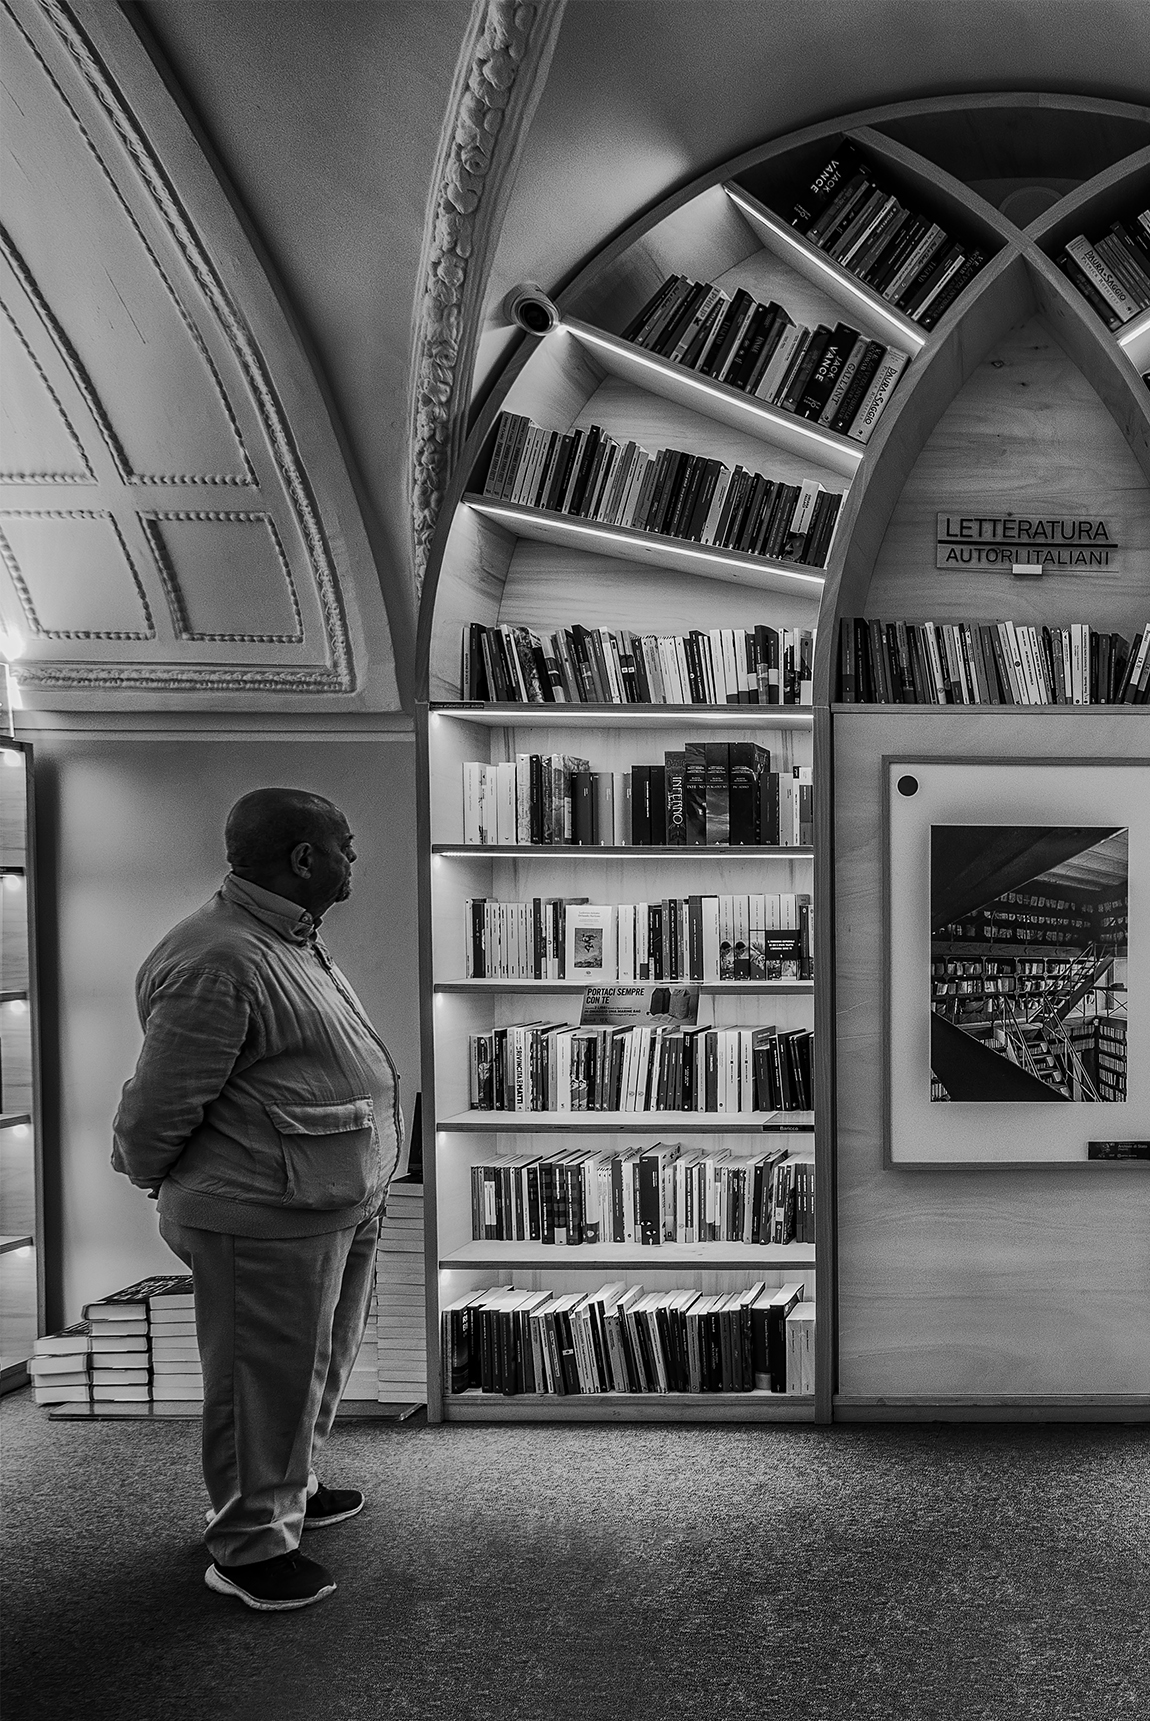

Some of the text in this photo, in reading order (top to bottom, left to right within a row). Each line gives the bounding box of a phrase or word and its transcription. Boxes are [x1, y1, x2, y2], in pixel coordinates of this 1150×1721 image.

[809, 157, 839, 193] VANCE
[821, 170, 842, 193] JACK
[814, 343, 838, 382] VANCE
[826, 354, 843, 380] JACK
[830, 361, 856, 406] GALLANT
[946, 518, 1109, 540] LETTERATURA
[945, 548, 1109, 566] AUTORI ITALIANI
[672, 775, 682, 825] INFERNO
[587, 988, 645, 996] PORTACI SEMPRE
